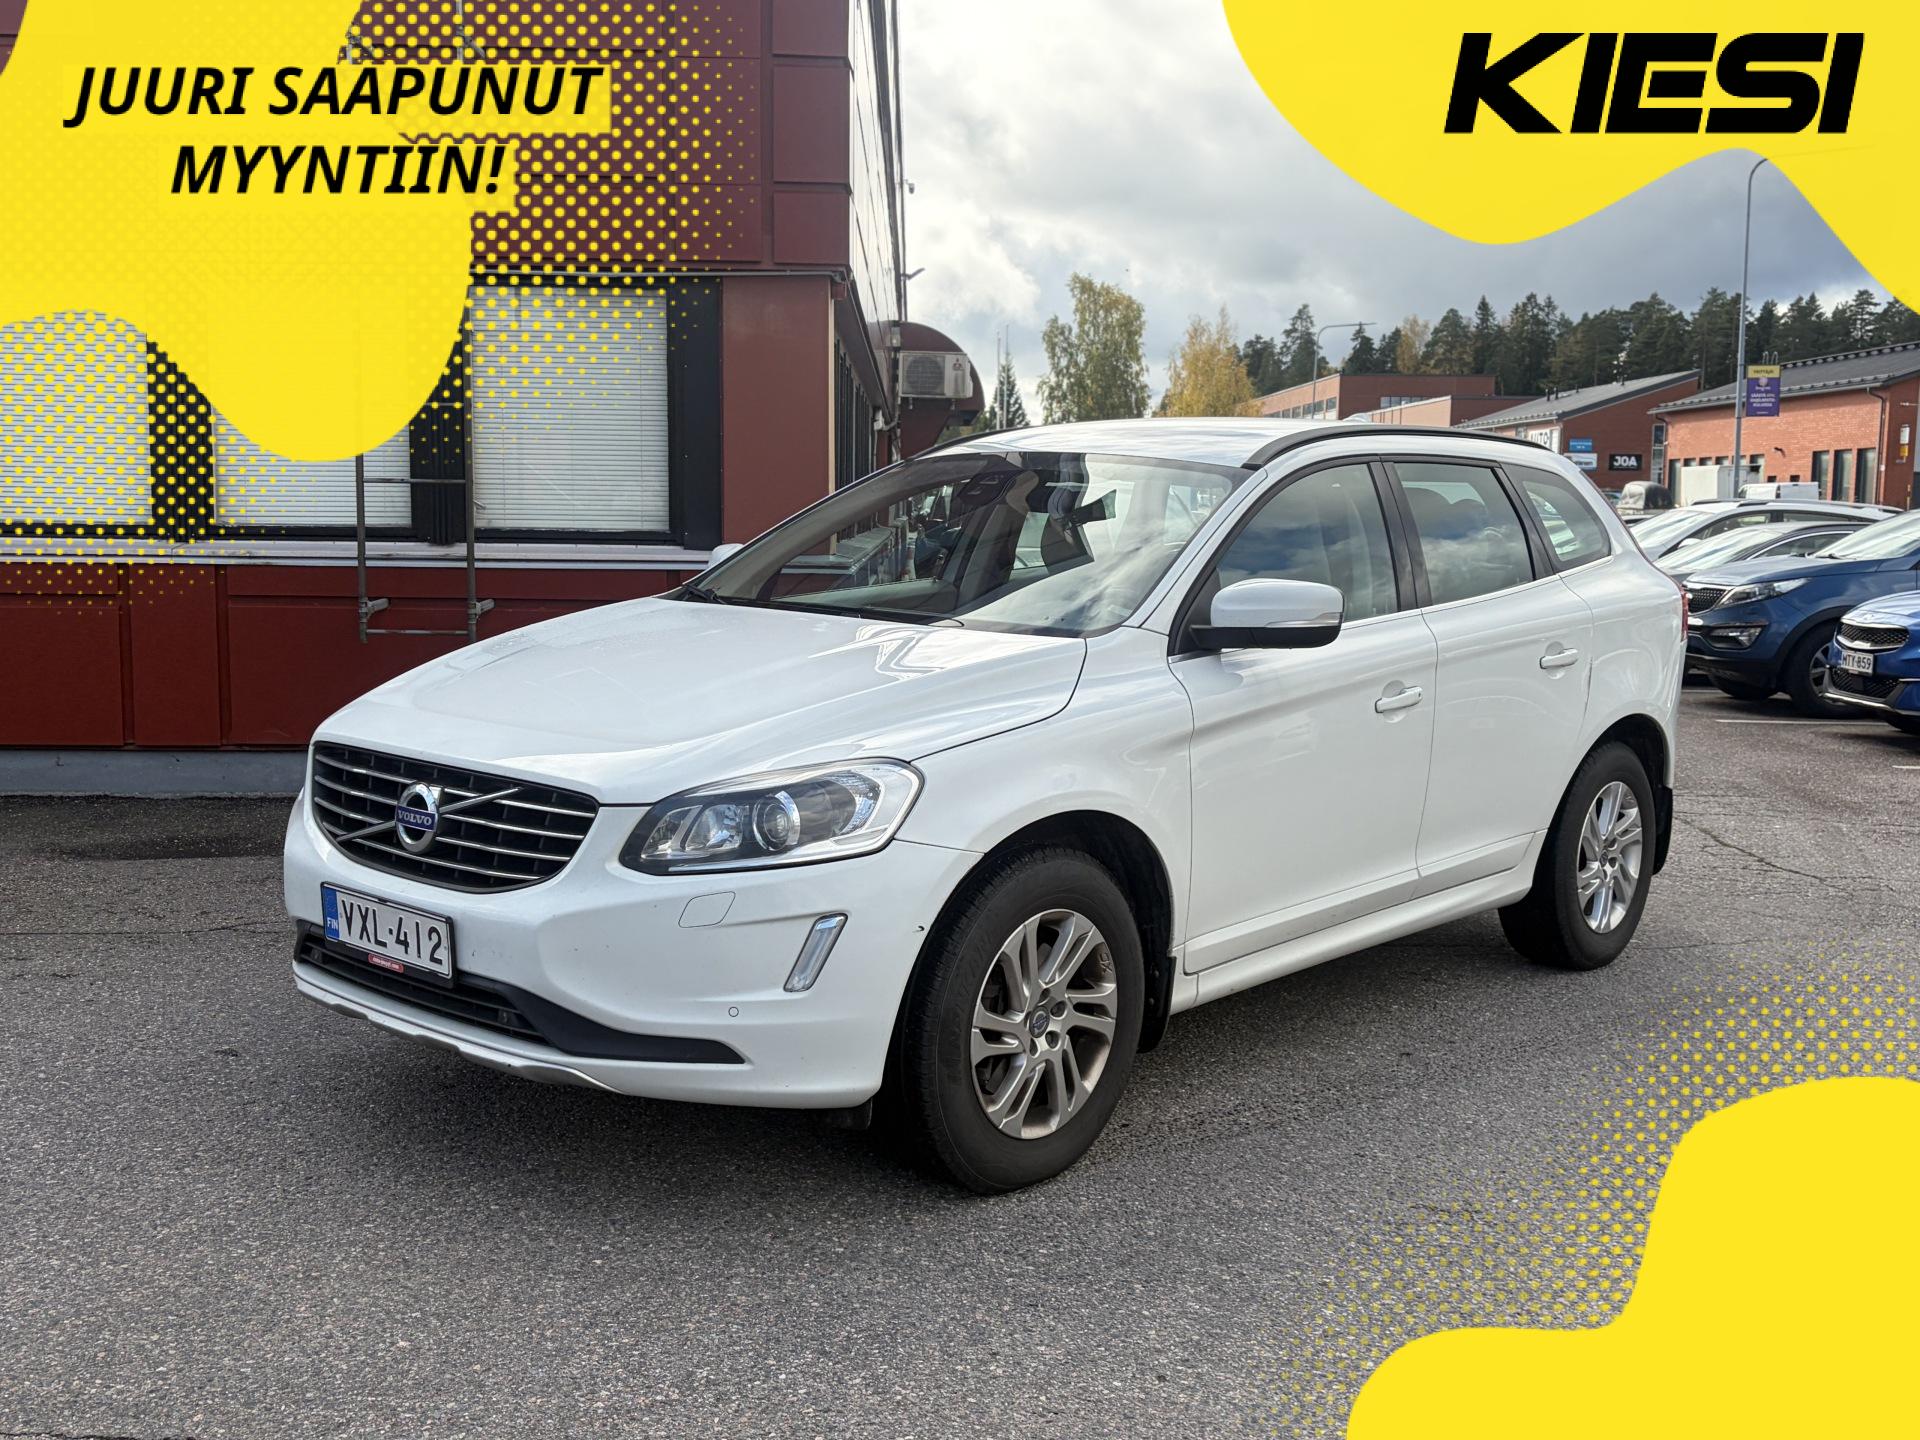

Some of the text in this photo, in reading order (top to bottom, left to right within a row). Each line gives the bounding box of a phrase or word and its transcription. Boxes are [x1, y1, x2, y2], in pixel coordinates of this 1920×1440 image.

[1613, 455, 1638, 467] JOA
[397, 808, 433, 827] VOLVO
[326, 917, 339, 931] FIN
[341, 899, 443, 966] VXL-412
